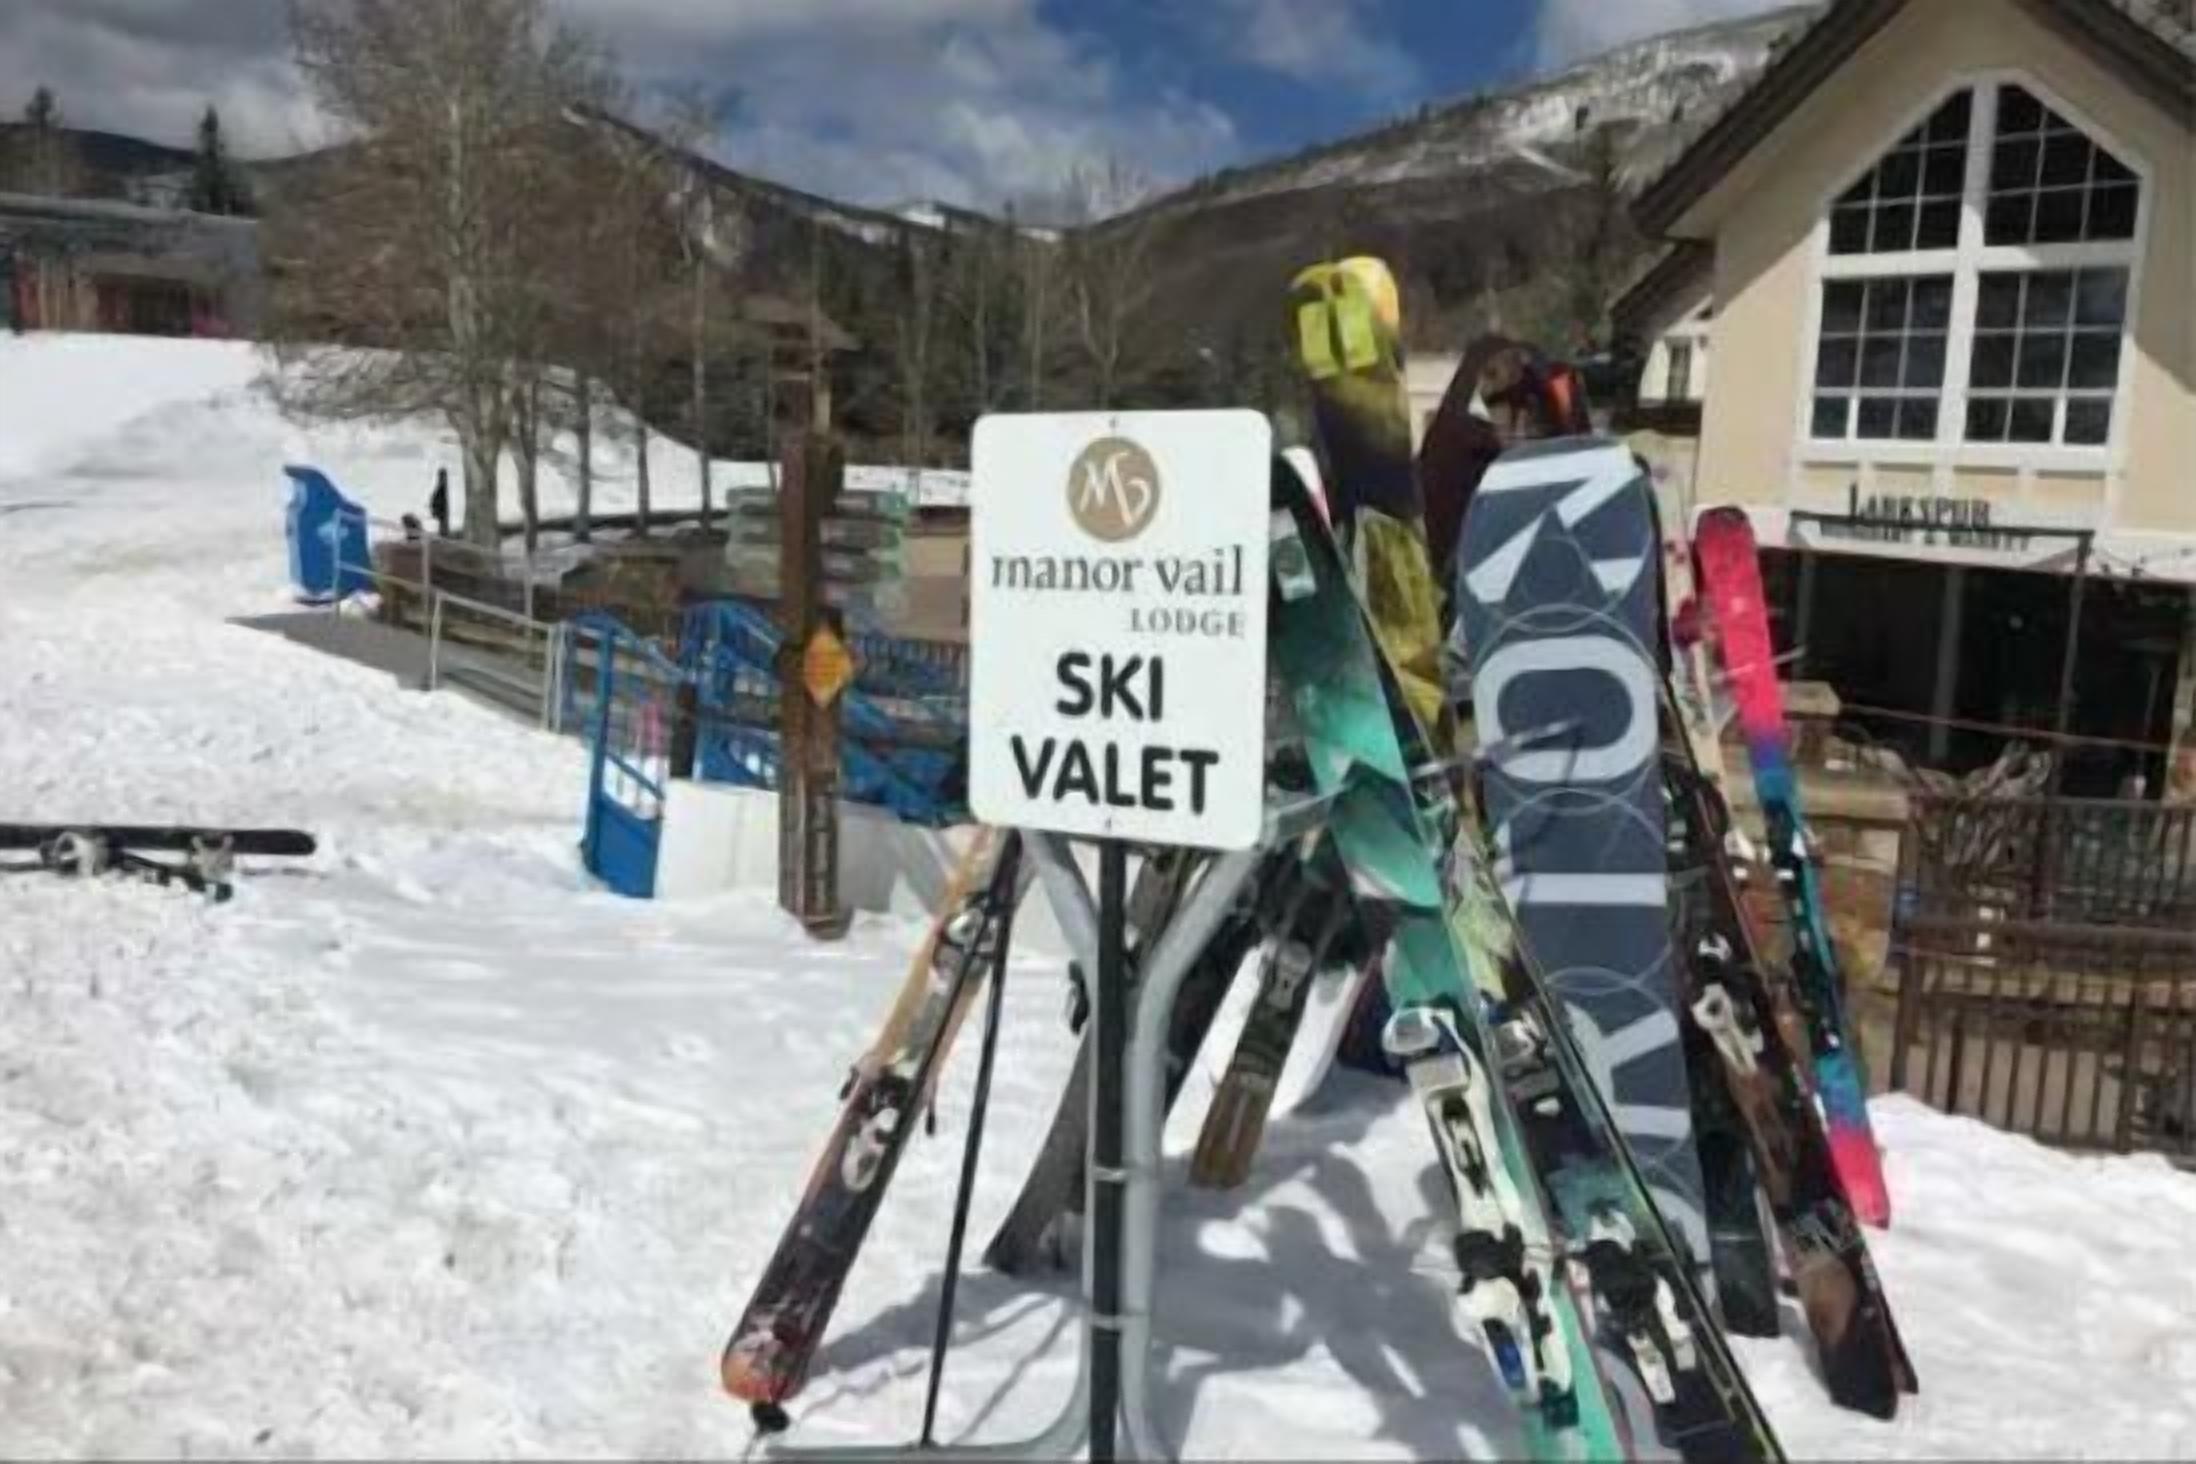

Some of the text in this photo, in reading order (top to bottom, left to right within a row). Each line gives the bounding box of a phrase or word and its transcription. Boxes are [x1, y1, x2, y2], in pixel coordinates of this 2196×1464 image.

[992, 543, 1244, 596] manor vail
[1131, 607, 1245, 638] LODGE
[1056, 650, 1164, 722] SKI
[1010, 733, 1219, 815] VALET
